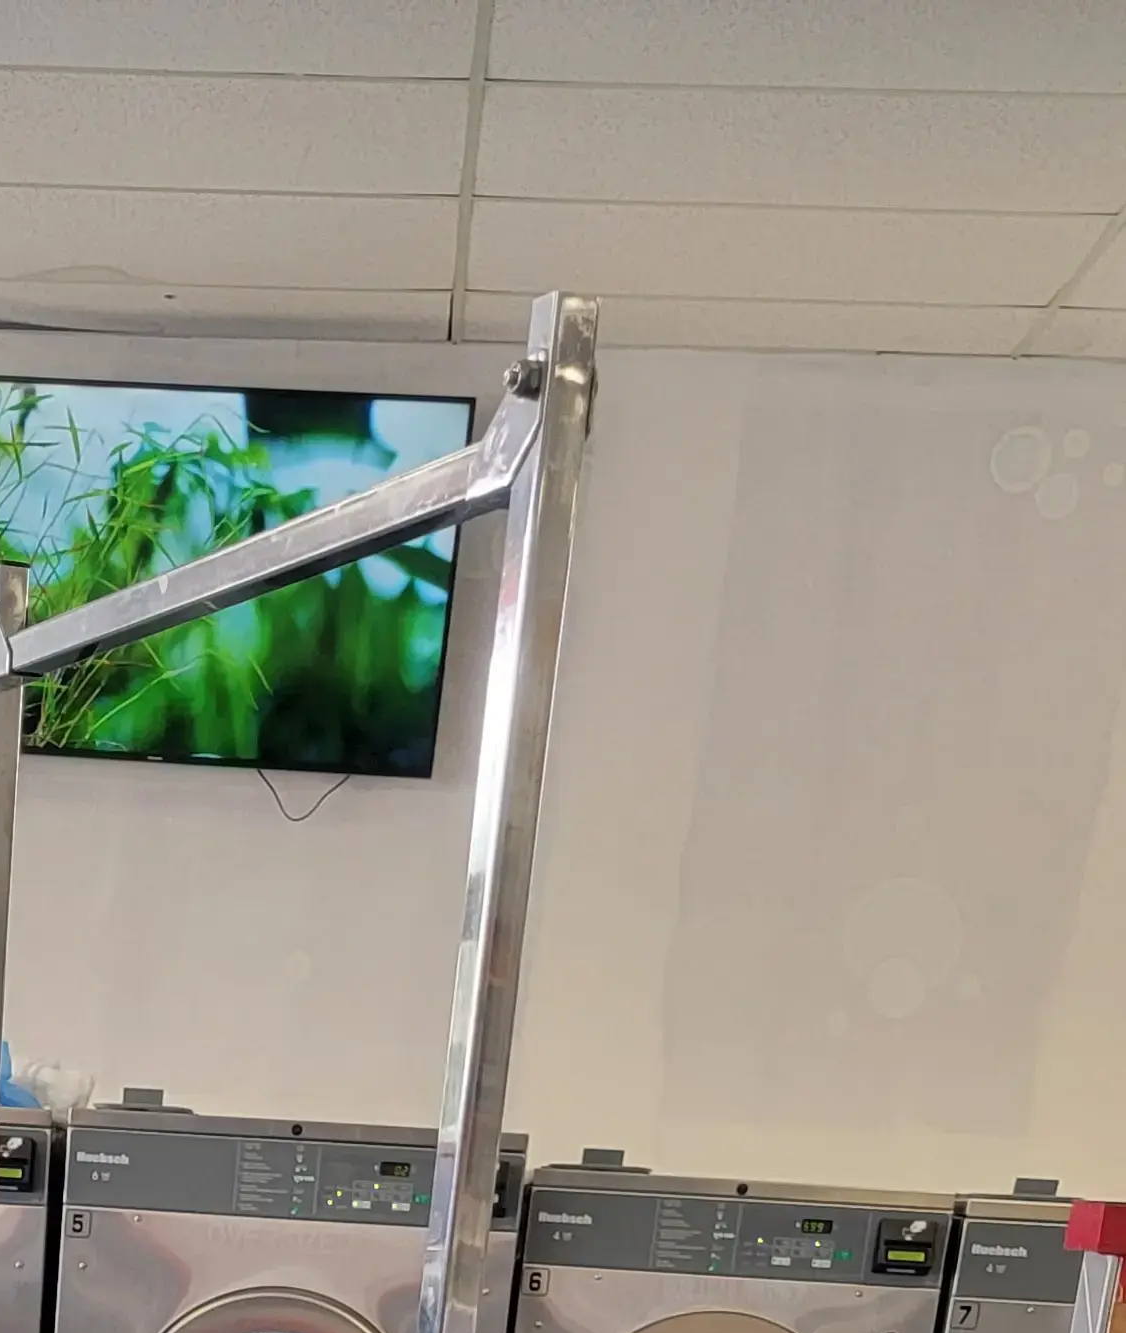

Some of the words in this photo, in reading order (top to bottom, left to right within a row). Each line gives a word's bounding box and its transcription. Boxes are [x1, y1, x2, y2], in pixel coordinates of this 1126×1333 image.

[72, 1214, 83, 1233] 5
[529, 1272, 541, 1291] 6
[959, 1305, 972, 1325] 7
